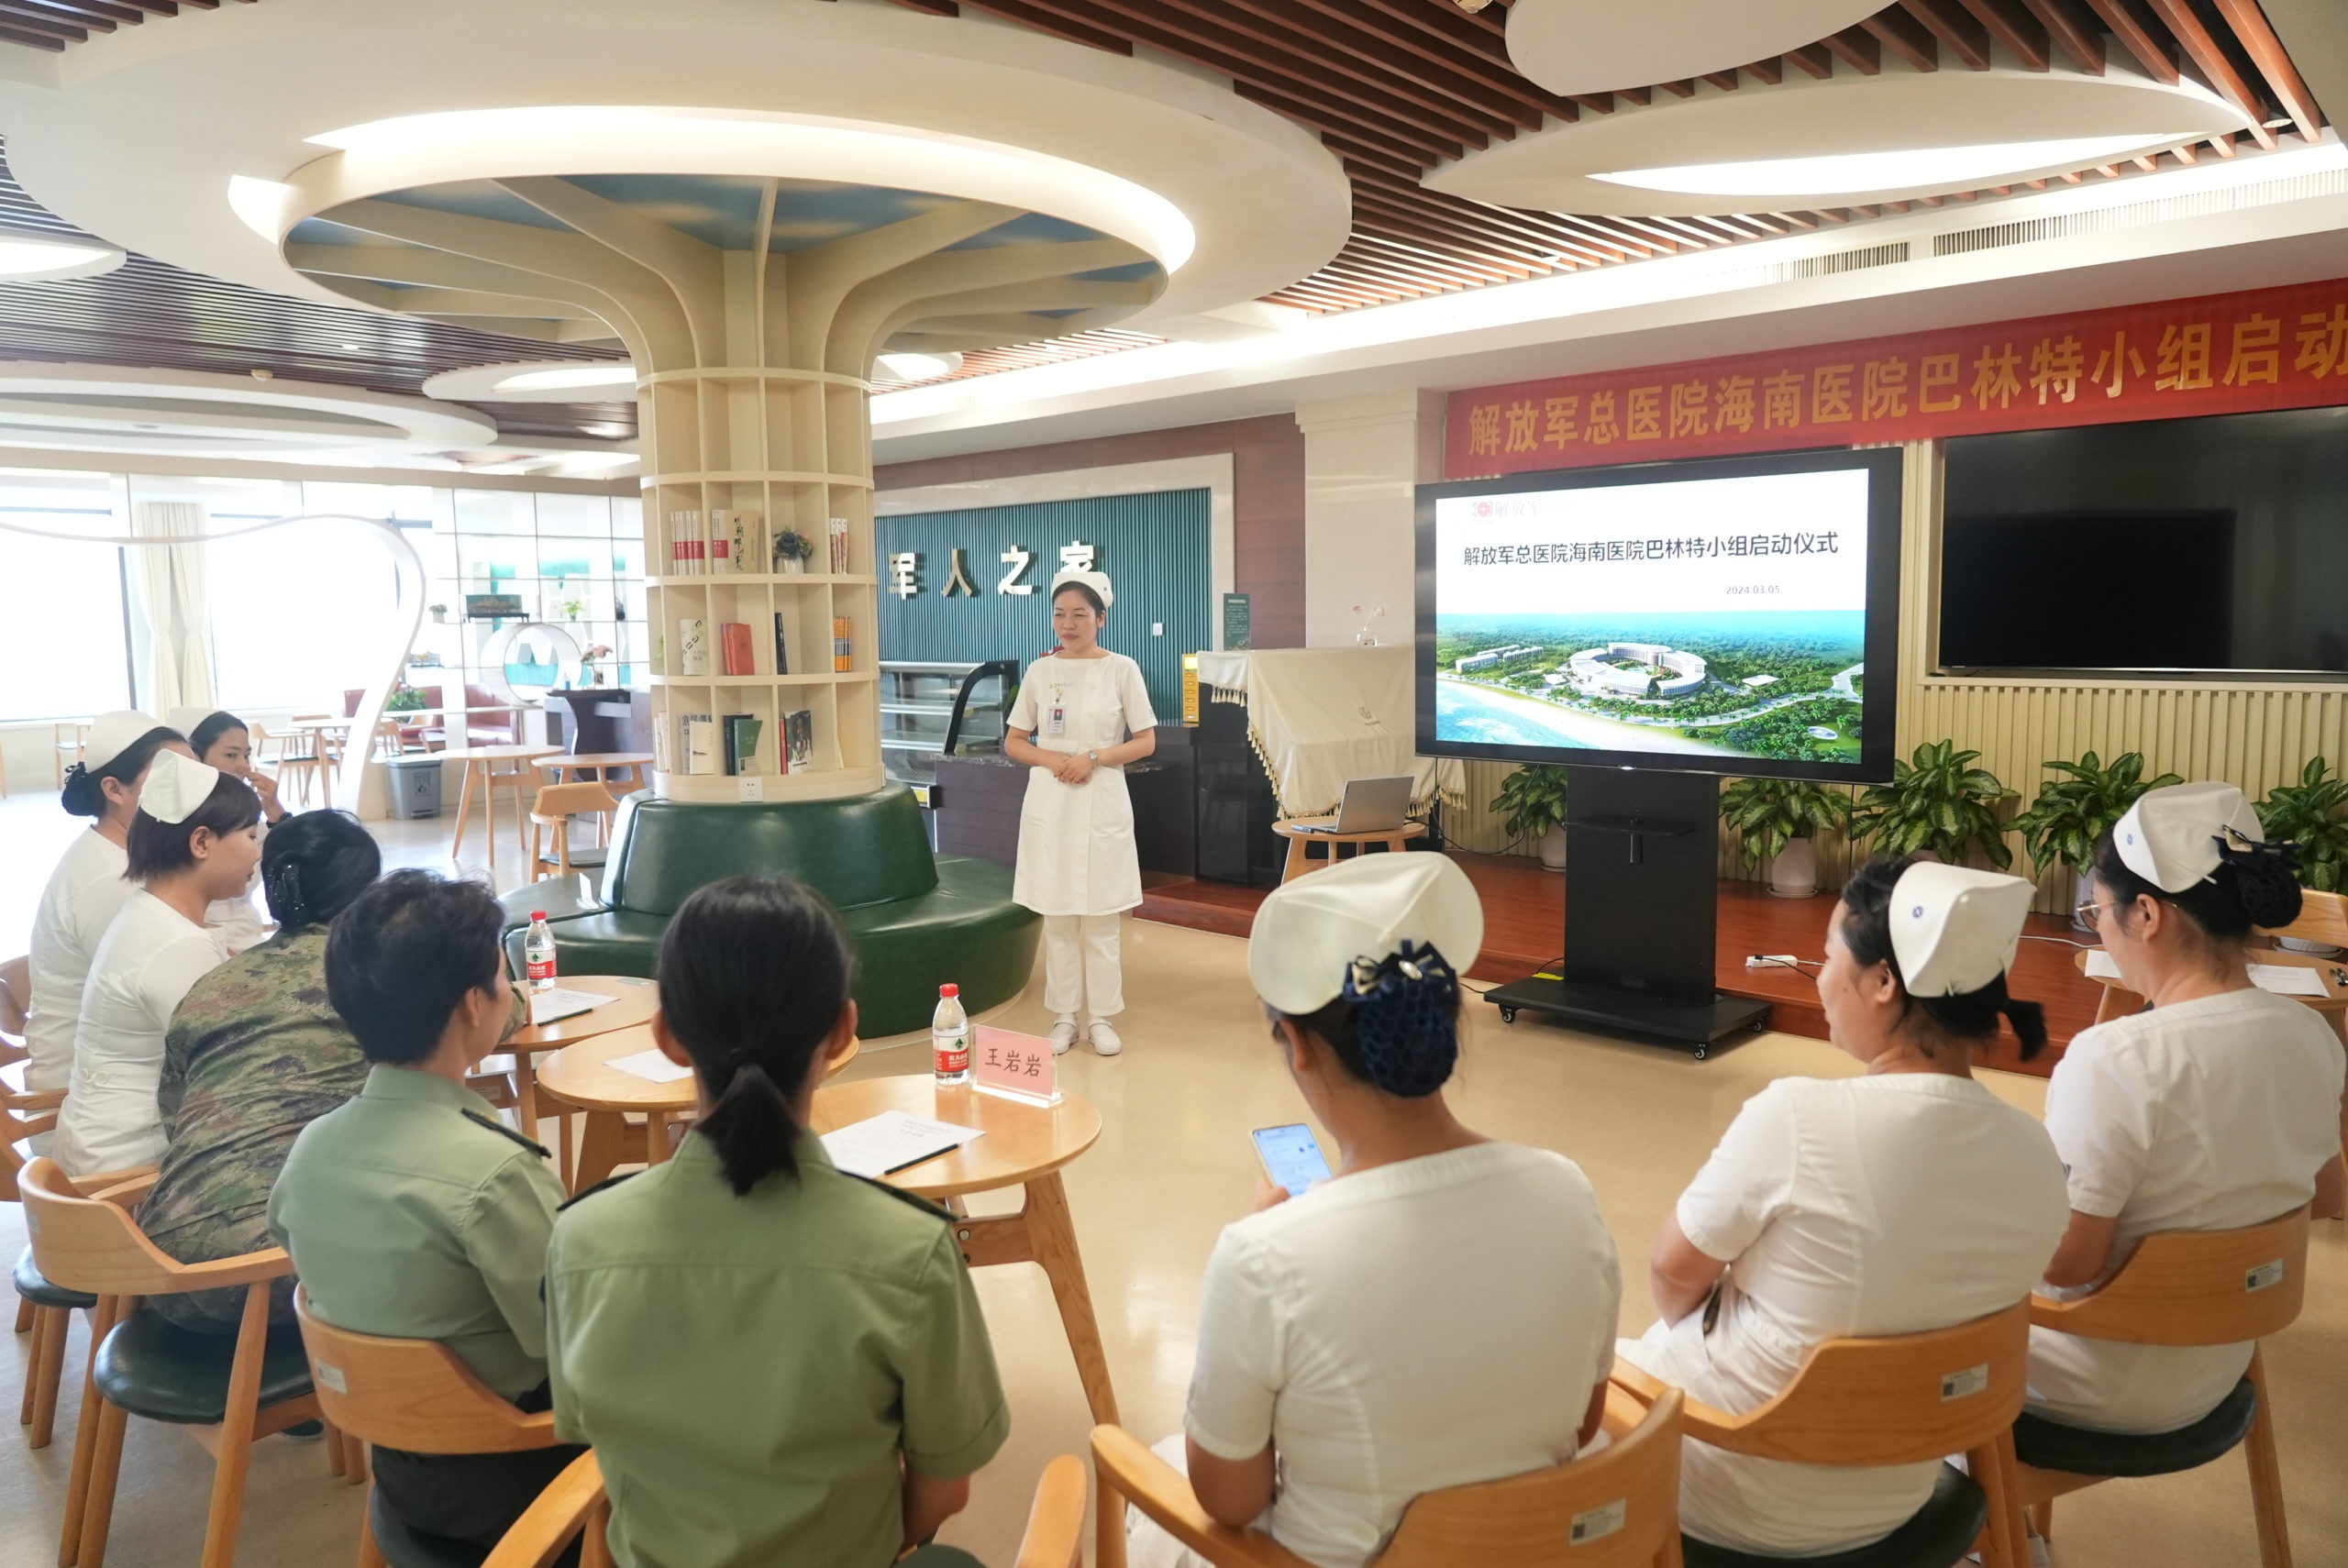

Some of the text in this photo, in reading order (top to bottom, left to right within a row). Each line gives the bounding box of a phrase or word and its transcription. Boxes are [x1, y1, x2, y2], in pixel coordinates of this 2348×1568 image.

[1468, 304, 2348, 457] 解放军总医院海南医院巴林特小组启动
[1463, 531, 1838, 566] 解放军总医院海南医院巴林特小组启动仪式
[1726, 585, 1780, 595] 2024.03.05
[984, 1048, 1041, 1077] 王岩岩
